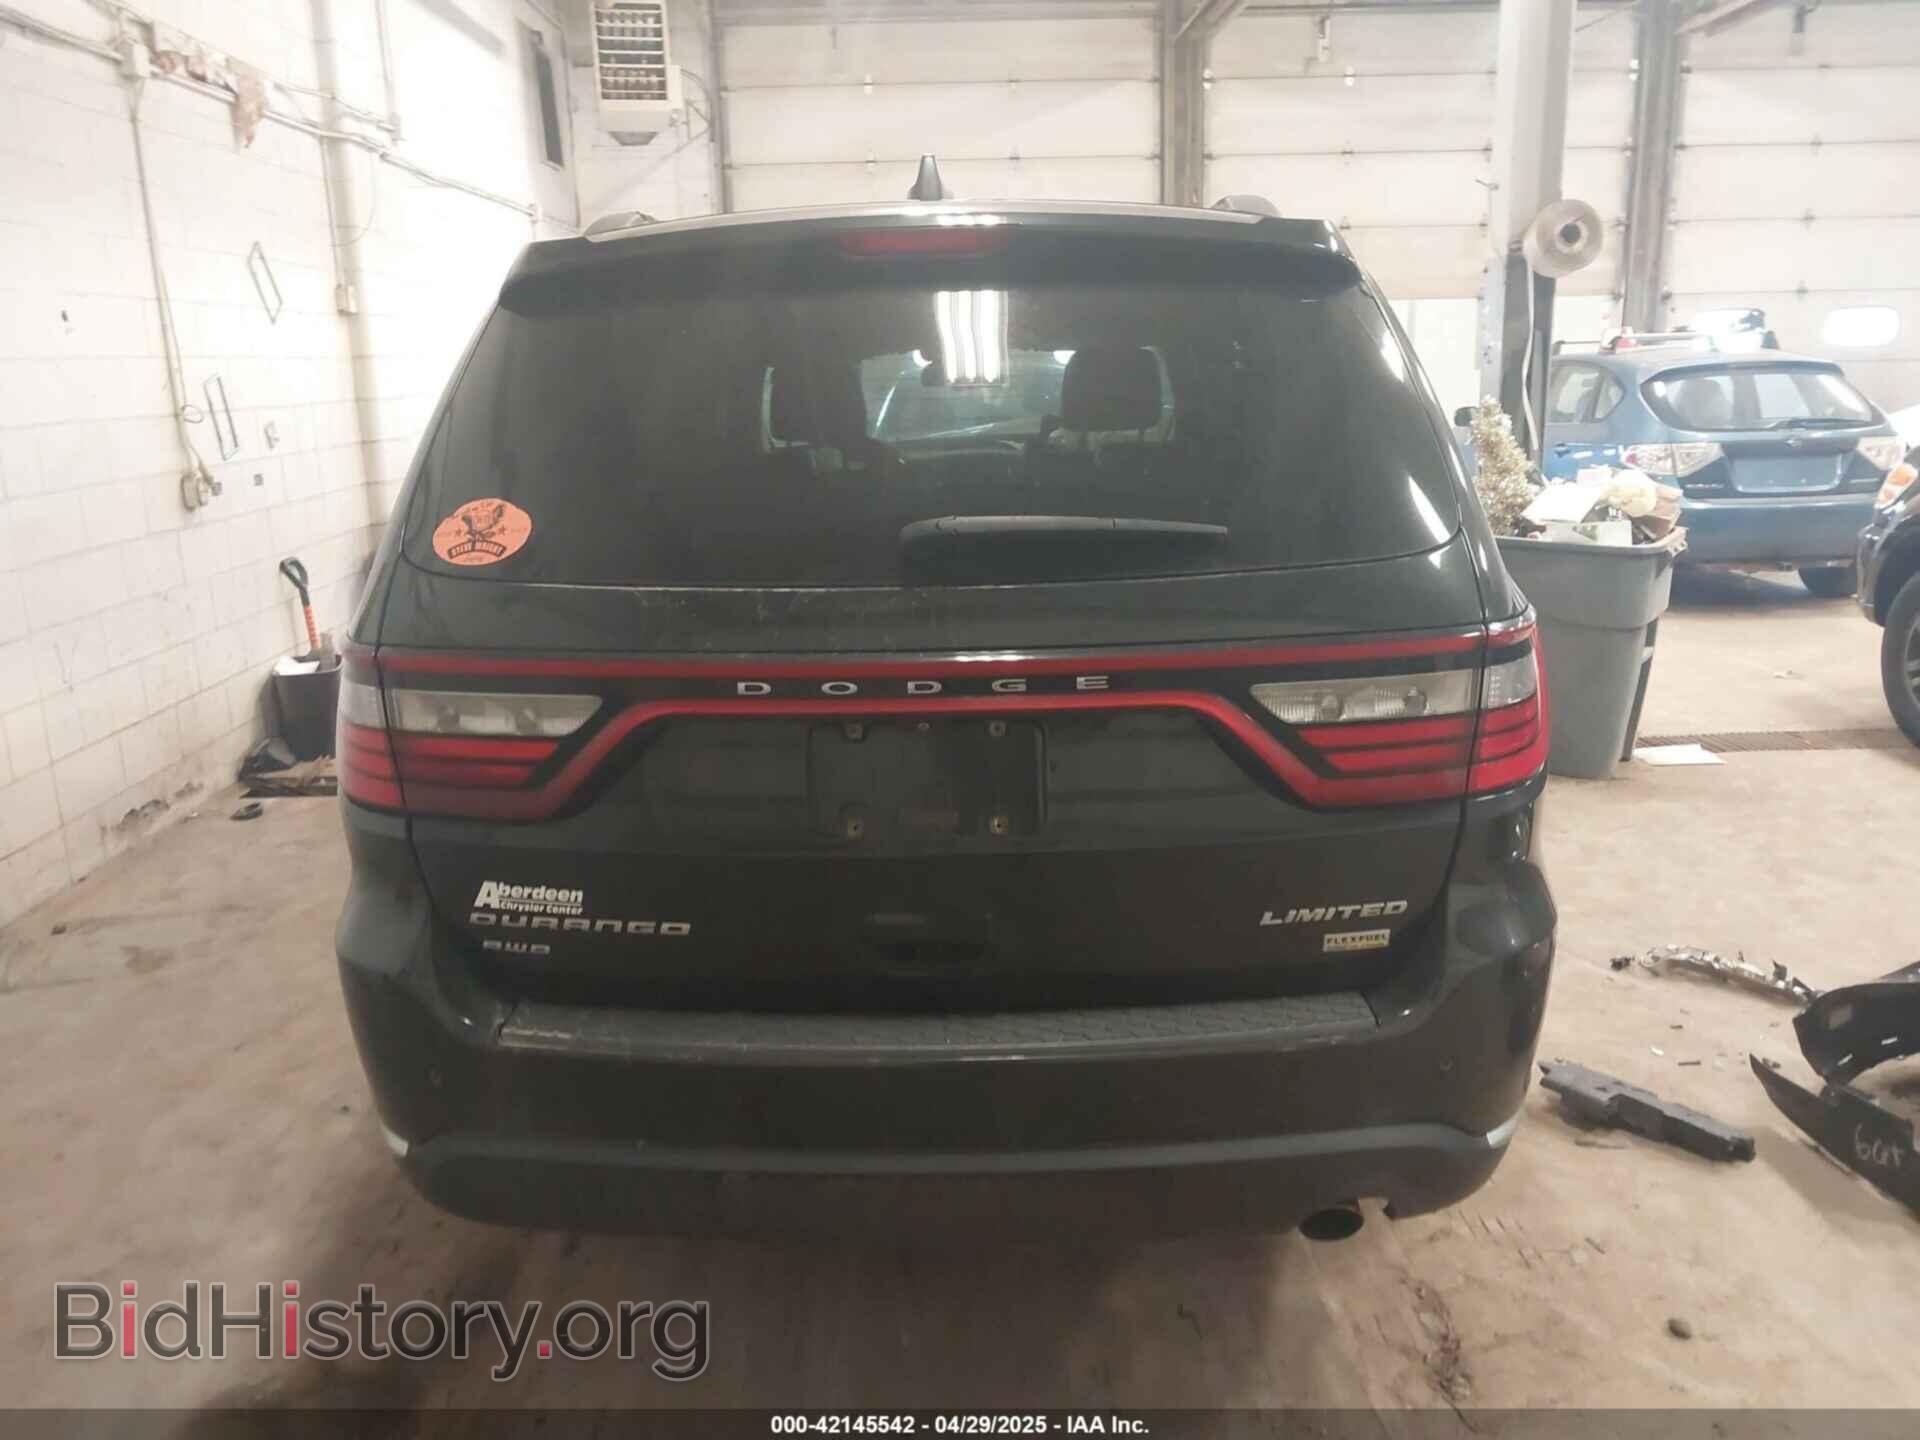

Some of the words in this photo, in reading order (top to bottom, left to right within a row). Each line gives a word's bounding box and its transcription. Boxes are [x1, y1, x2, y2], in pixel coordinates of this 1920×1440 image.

[737, 675, 1110, 694] DODGE
[473, 880, 584, 908] Aberdeen
[499, 902, 545, 914] Chrysler
[546, 904, 584, 916] Center
[1259, 900, 1408, 926] LIMITED
[469, 912, 692, 935] DURANGO
[482, 940, 551, 955] AWD
